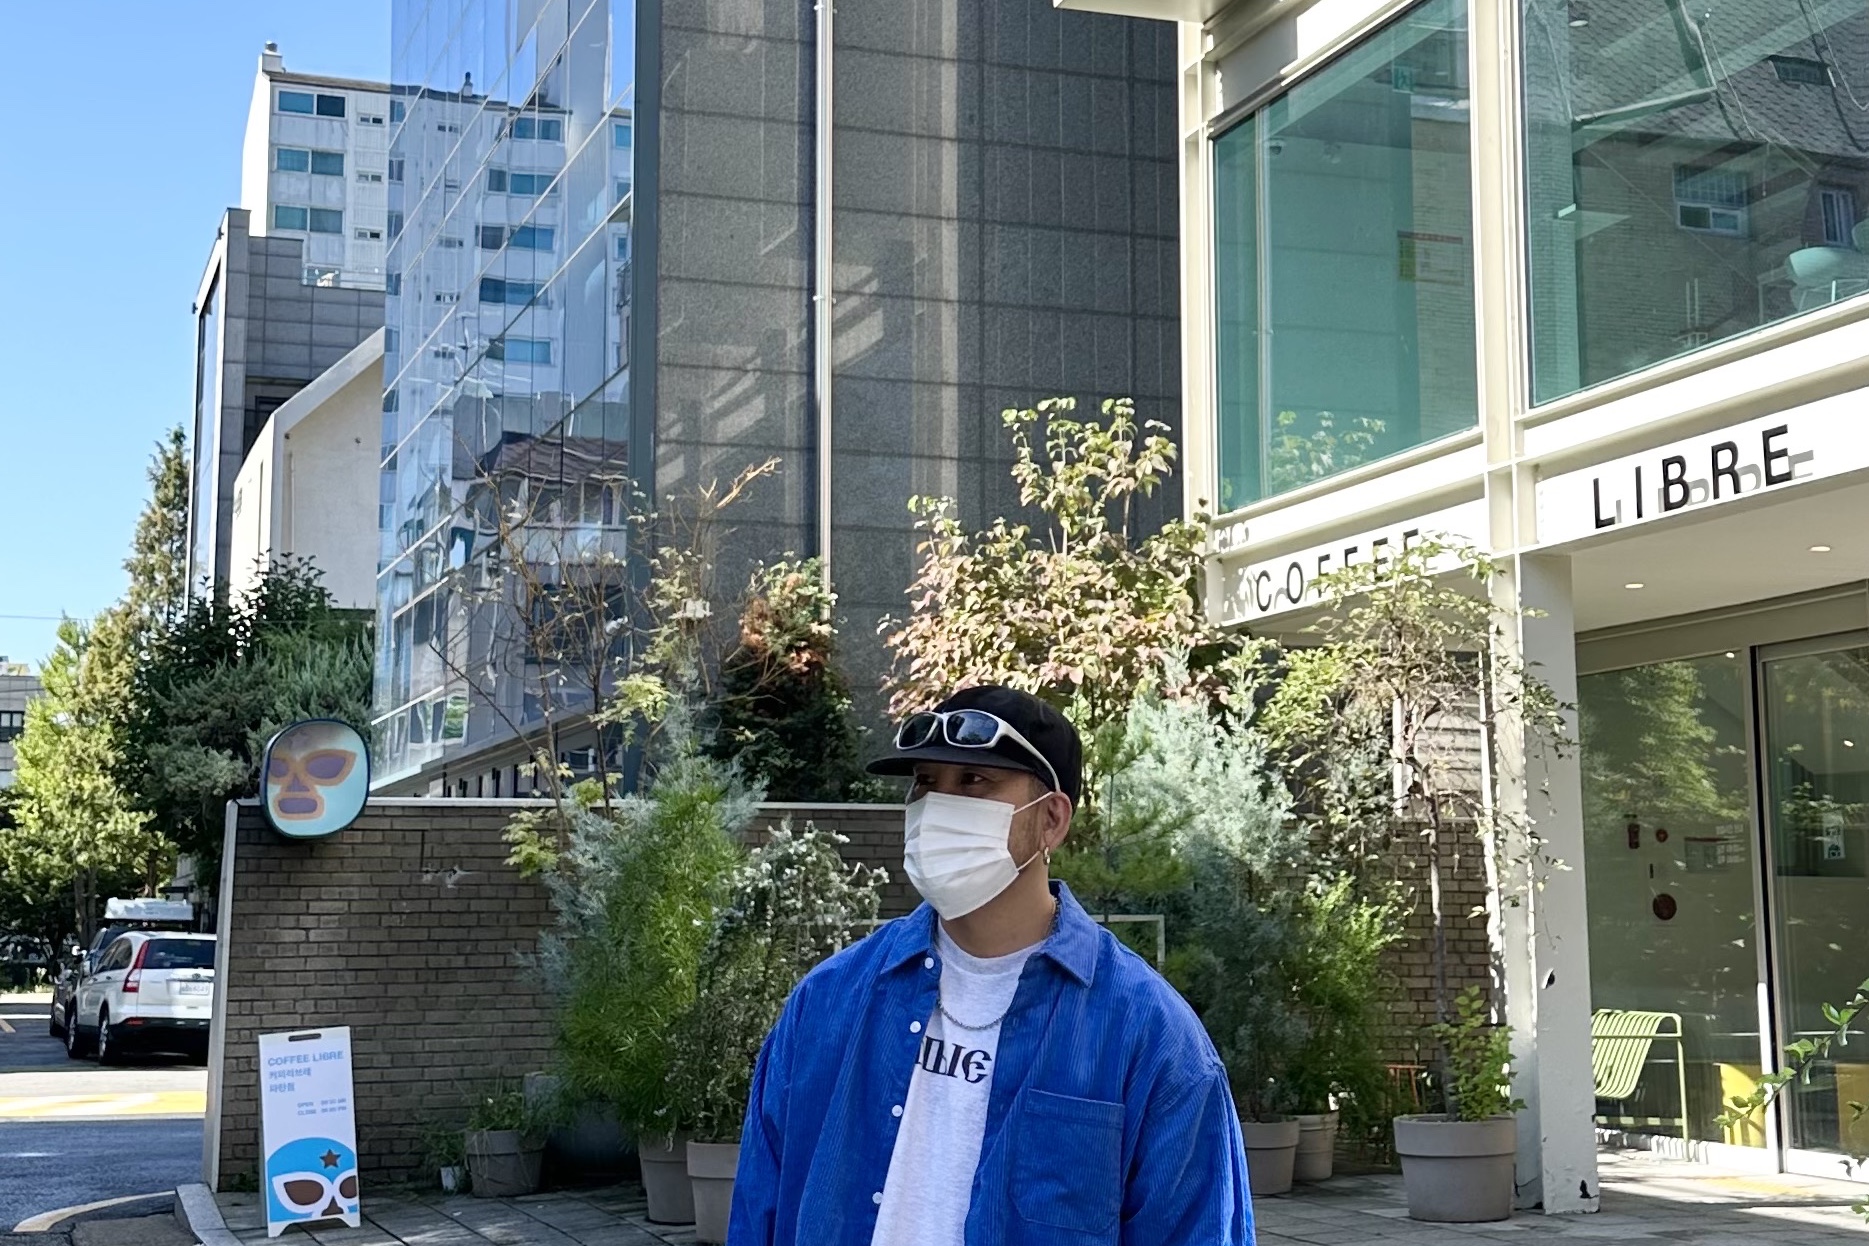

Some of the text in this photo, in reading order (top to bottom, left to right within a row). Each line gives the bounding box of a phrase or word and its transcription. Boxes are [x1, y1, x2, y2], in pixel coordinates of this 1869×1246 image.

[1593, 424, 1792, 529] LIBRE
[268, 1050, 344, 1066] COFFEE LIBRE
